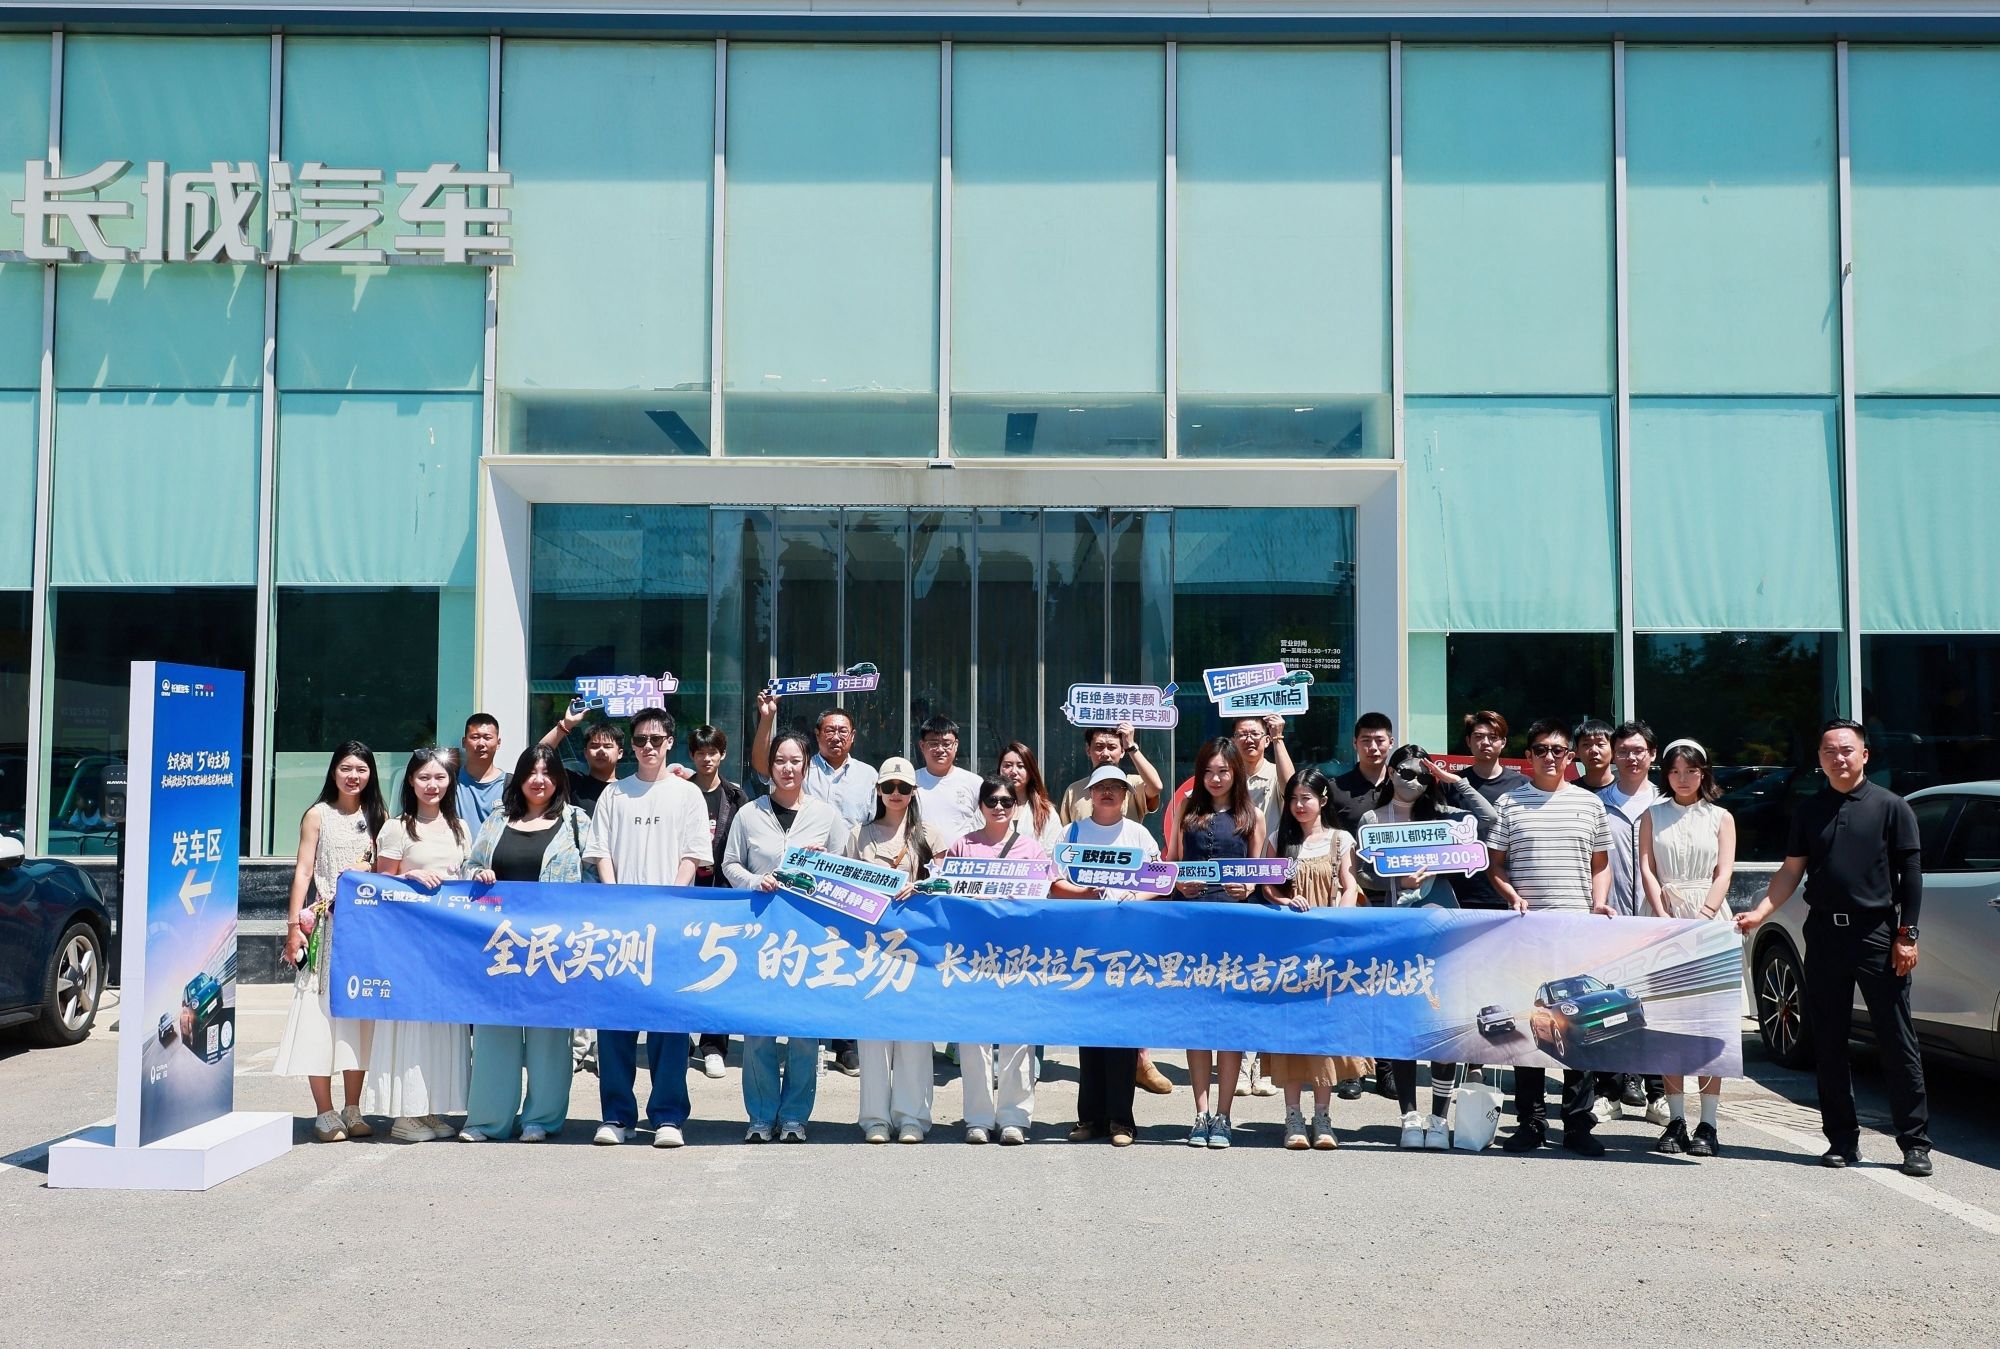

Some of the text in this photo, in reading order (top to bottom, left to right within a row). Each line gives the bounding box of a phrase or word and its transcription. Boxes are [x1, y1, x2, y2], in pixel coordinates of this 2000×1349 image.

[11, 159, 514, 263] 长城汽车
[1280, 639, 1308, 648] 营业时间
[577, 678, 654, 697] 平顺实力
[1212, 668, 1275, 693] 车位到车位
[1076, 691, 1155, 706] 拒绝参数美颜
[1231, 689, 1302, 708] 全程不断点
[1079, 707, 1171, 723] 真油耗全民实测
[1368, 828, 1447, 845] 到哪儿都好停
[172, 829, 222, 867] 发车区
[1081, 849, 1132, 865] 欧拉5
[1386, 851, 1480, 869] 泊车类型 200+
[944, 860, 1031, 877] 欧拉5混动版
[1222, 864, 1282, 877] 实测见真章
[1077, 869, 1171, 889] 始终快人一步
[381, 889, 431, 904] 长城汽车
[816, 879, 879, 914] 快顺静省
[483, 919, 657, 987] 全民实测
[362, 978, 392, 986] ORA
[937, 942, 1441, 1011] 长城欧拉5百公里油耗吉尼斯大挑战
[361, 987, 391, 999] 欧拉
